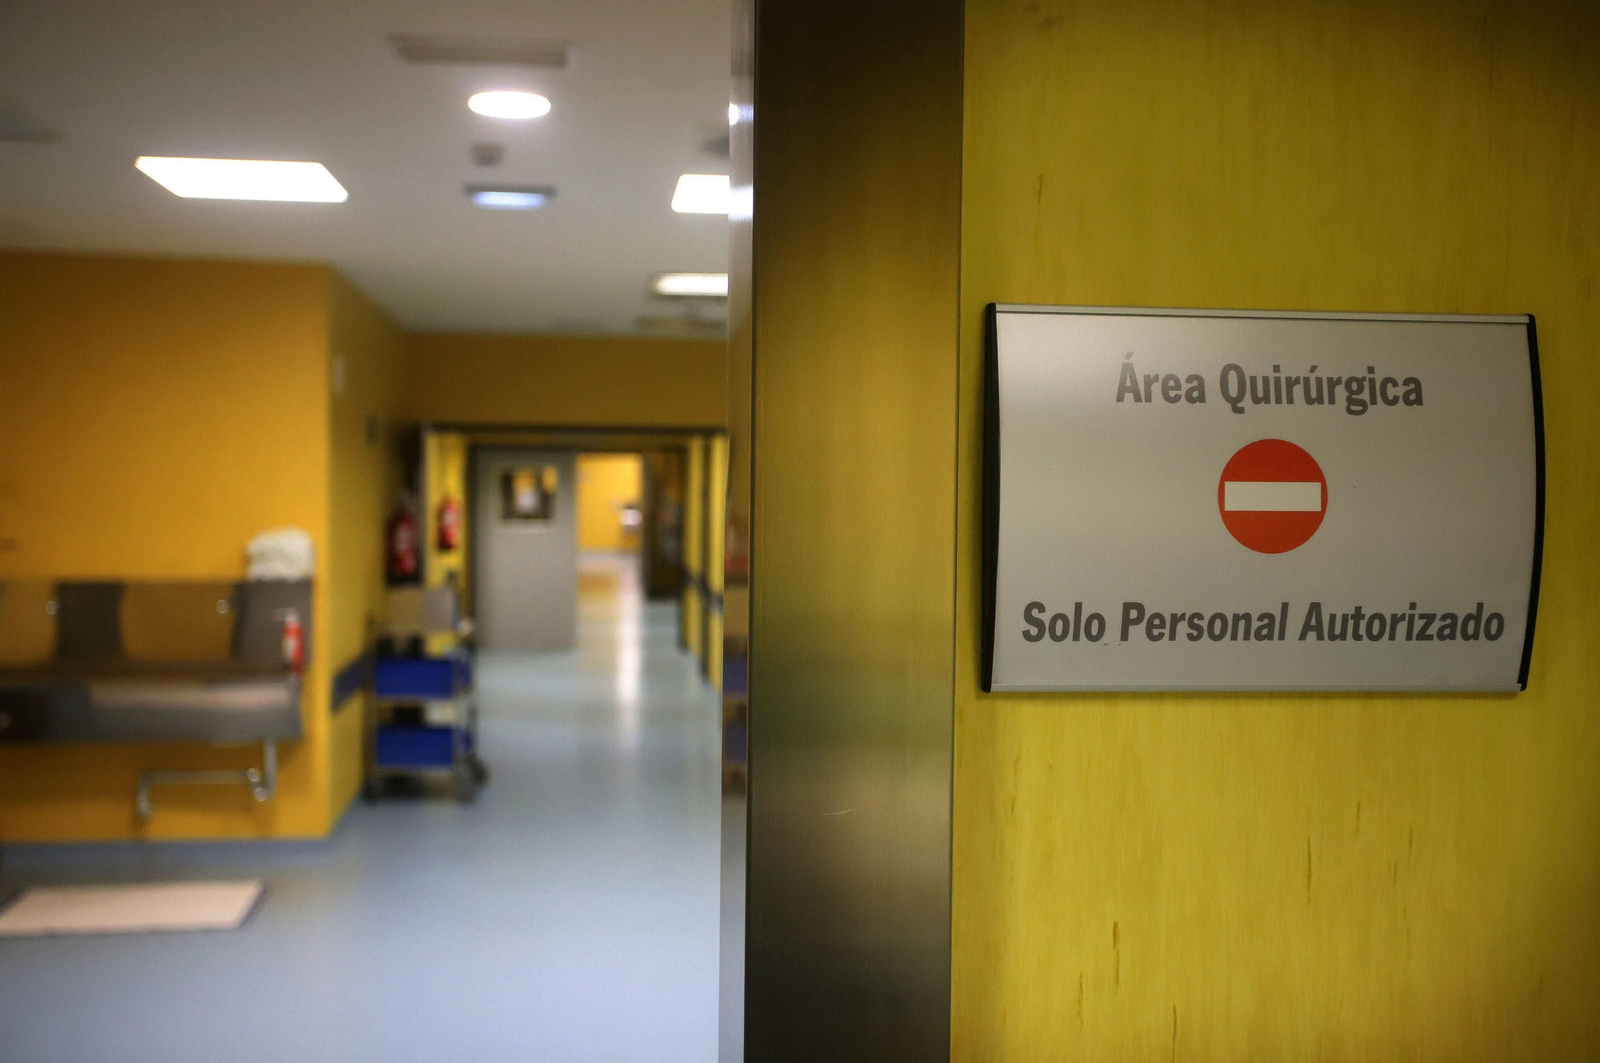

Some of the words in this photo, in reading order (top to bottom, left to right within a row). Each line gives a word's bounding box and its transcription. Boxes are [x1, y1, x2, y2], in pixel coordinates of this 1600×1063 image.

[1115, 351, 1207, 404] Área
[1218, 362, 1424, 416] Quirúrgica
[1022, 601, 1106, 643] Solo
[1120, 601, 1289, 643] Personal
[1298, 601, 1506, 642] Autorizado
